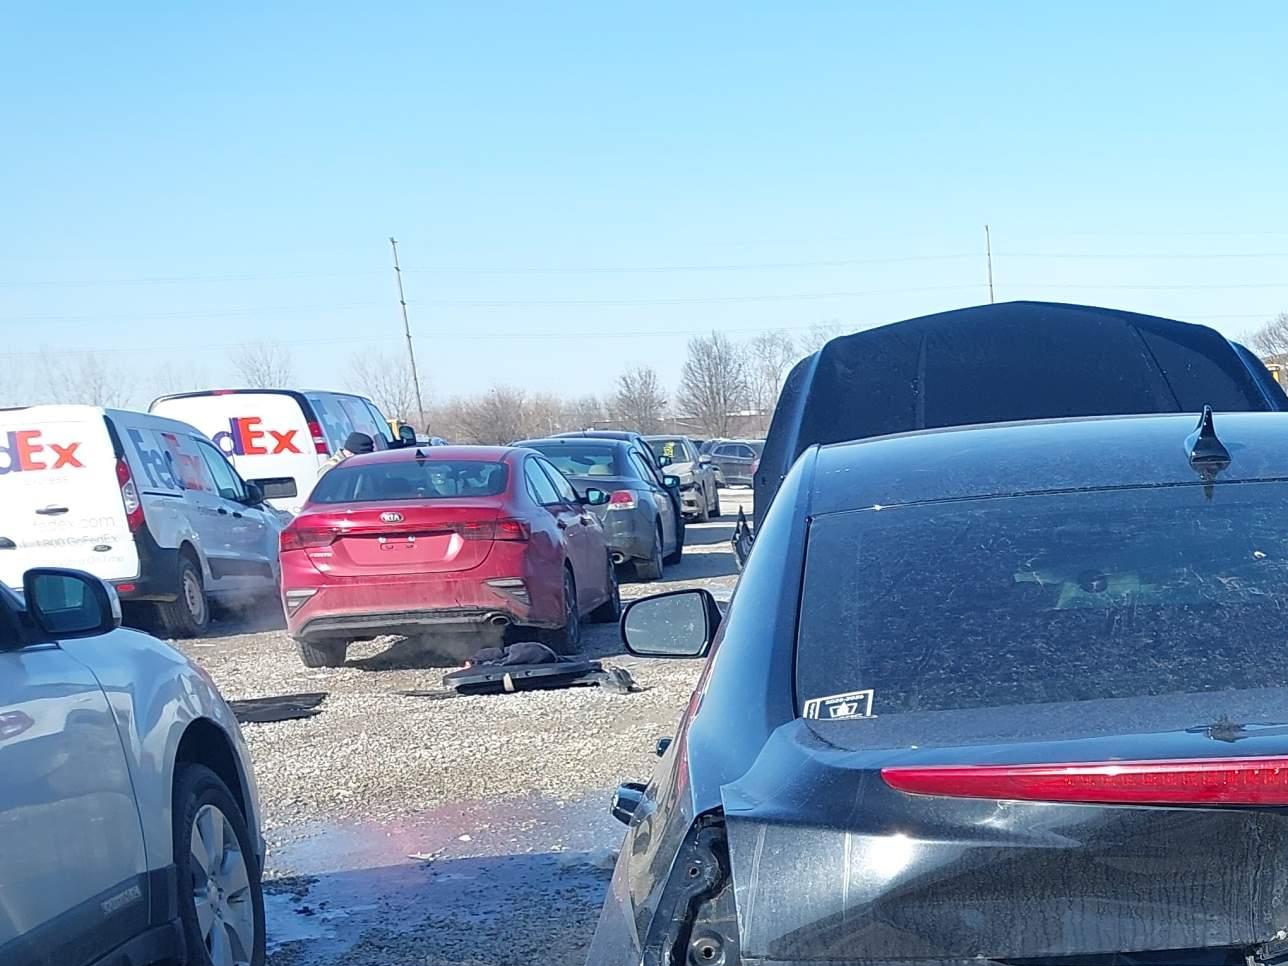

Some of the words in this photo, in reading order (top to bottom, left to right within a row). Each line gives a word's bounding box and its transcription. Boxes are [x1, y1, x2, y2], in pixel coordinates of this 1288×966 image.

[0, 429, 86, 475] dEx
[212, 416, 303, 457] dEx
[381, 511, 403, 523] KIA
